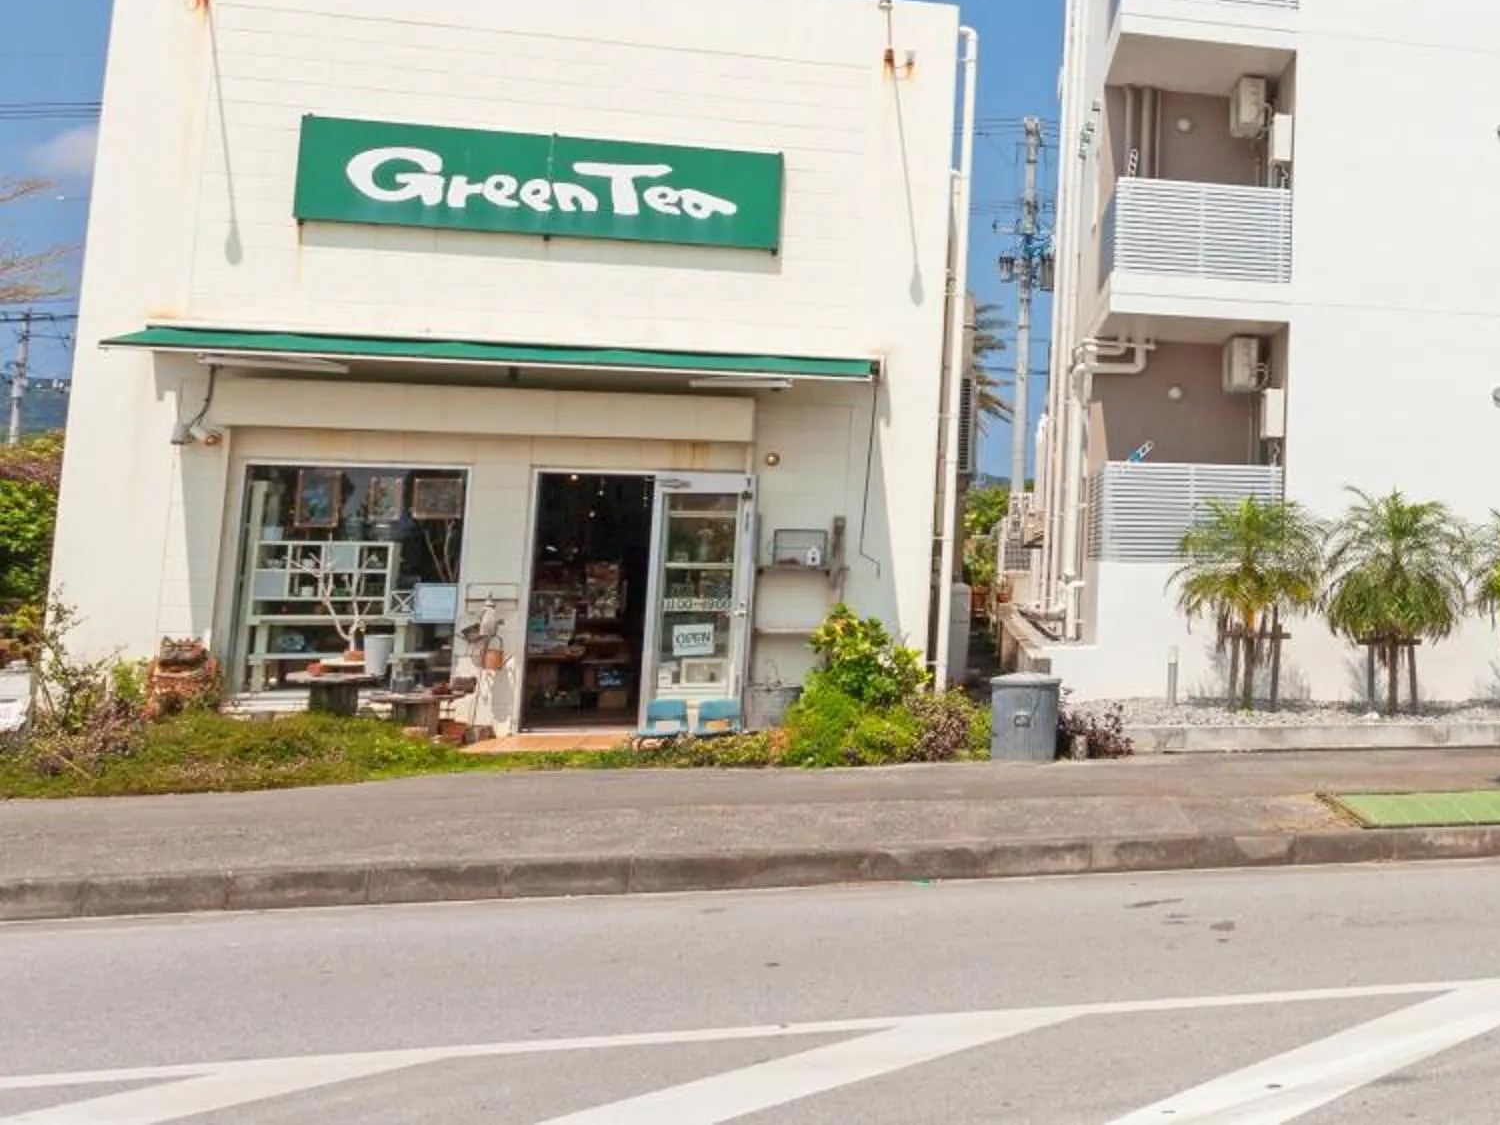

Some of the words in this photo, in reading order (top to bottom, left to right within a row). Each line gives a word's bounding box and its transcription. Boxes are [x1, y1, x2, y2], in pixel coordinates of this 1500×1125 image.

[346, 147, 598, 212] Green
[573, 161, 737, 219] Tea
[675, 632, 711, 647] OPEN
